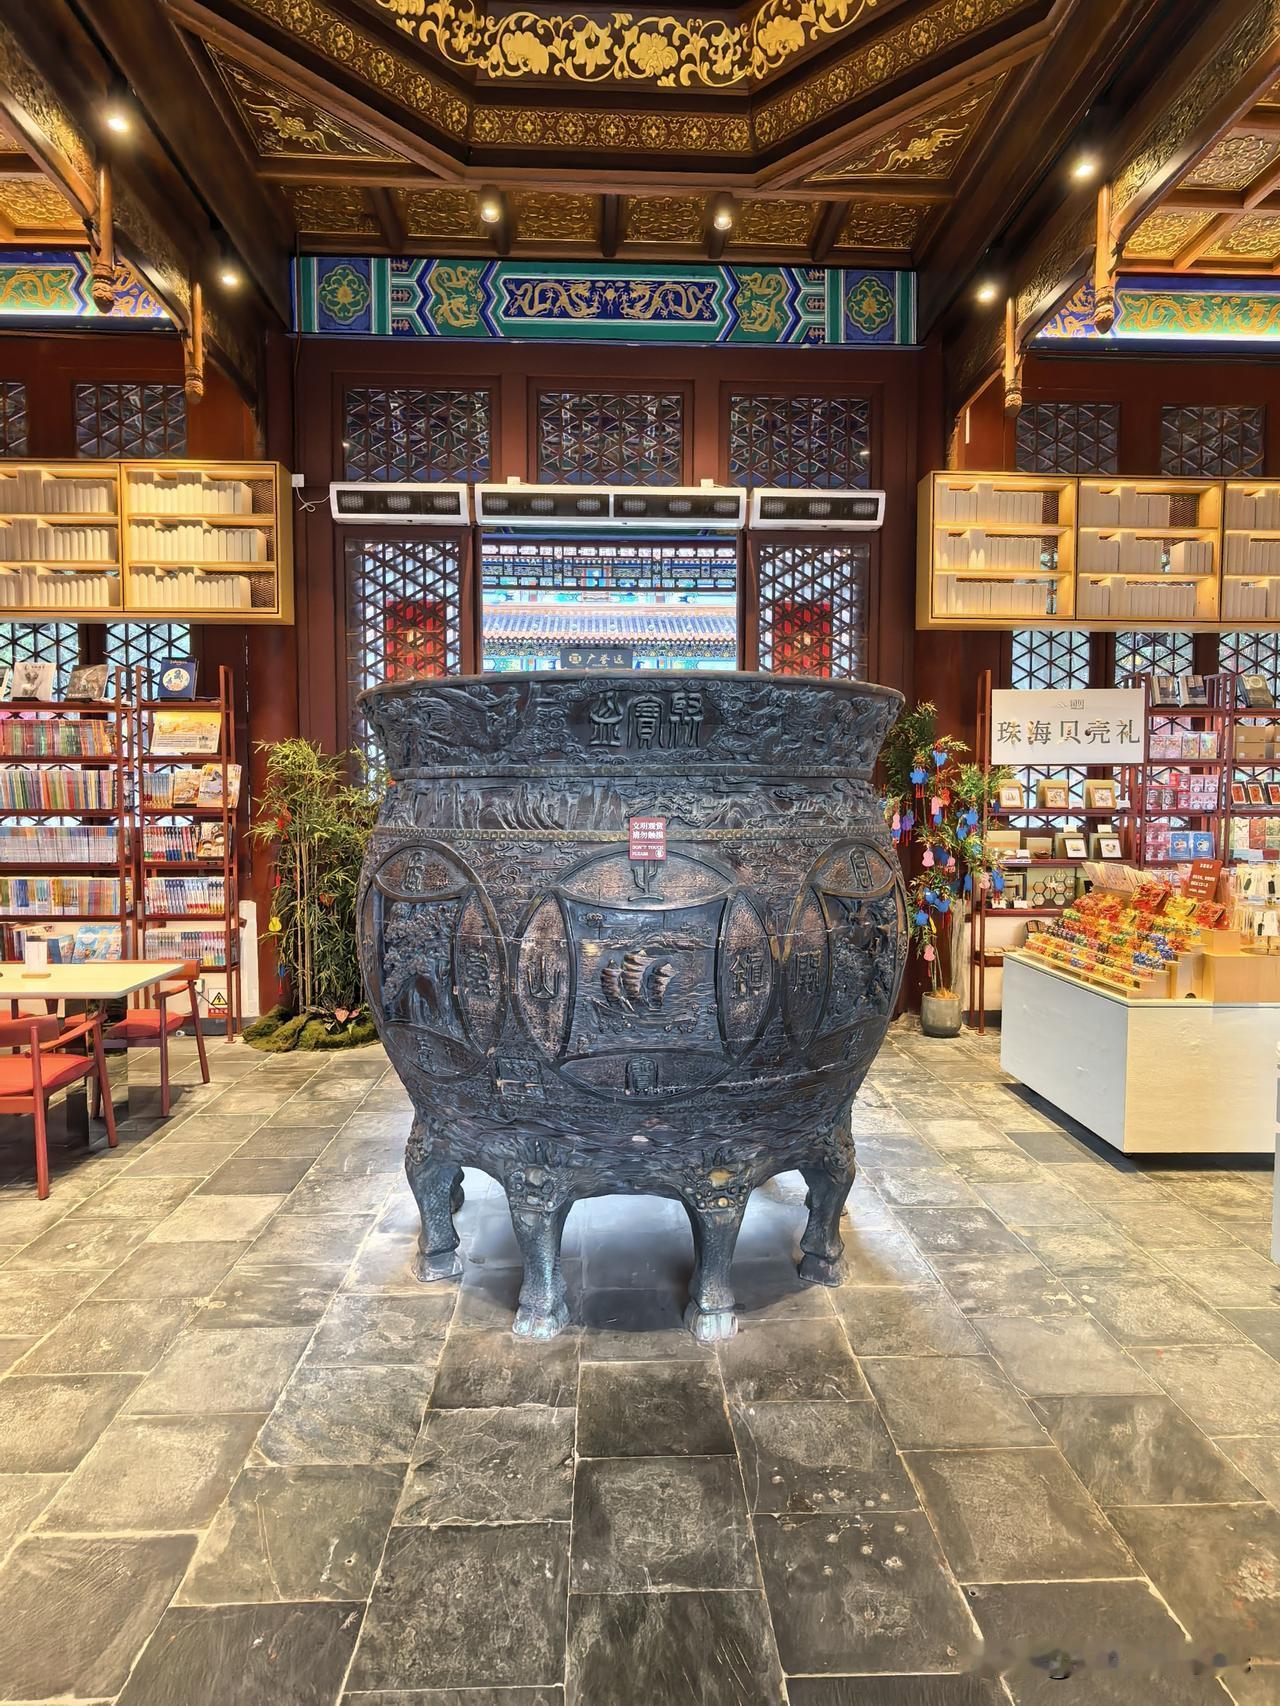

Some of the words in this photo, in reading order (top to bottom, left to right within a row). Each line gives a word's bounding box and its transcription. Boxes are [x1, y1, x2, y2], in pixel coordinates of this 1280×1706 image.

[997, 719, 1140, 745] 珠海贝壳礼
